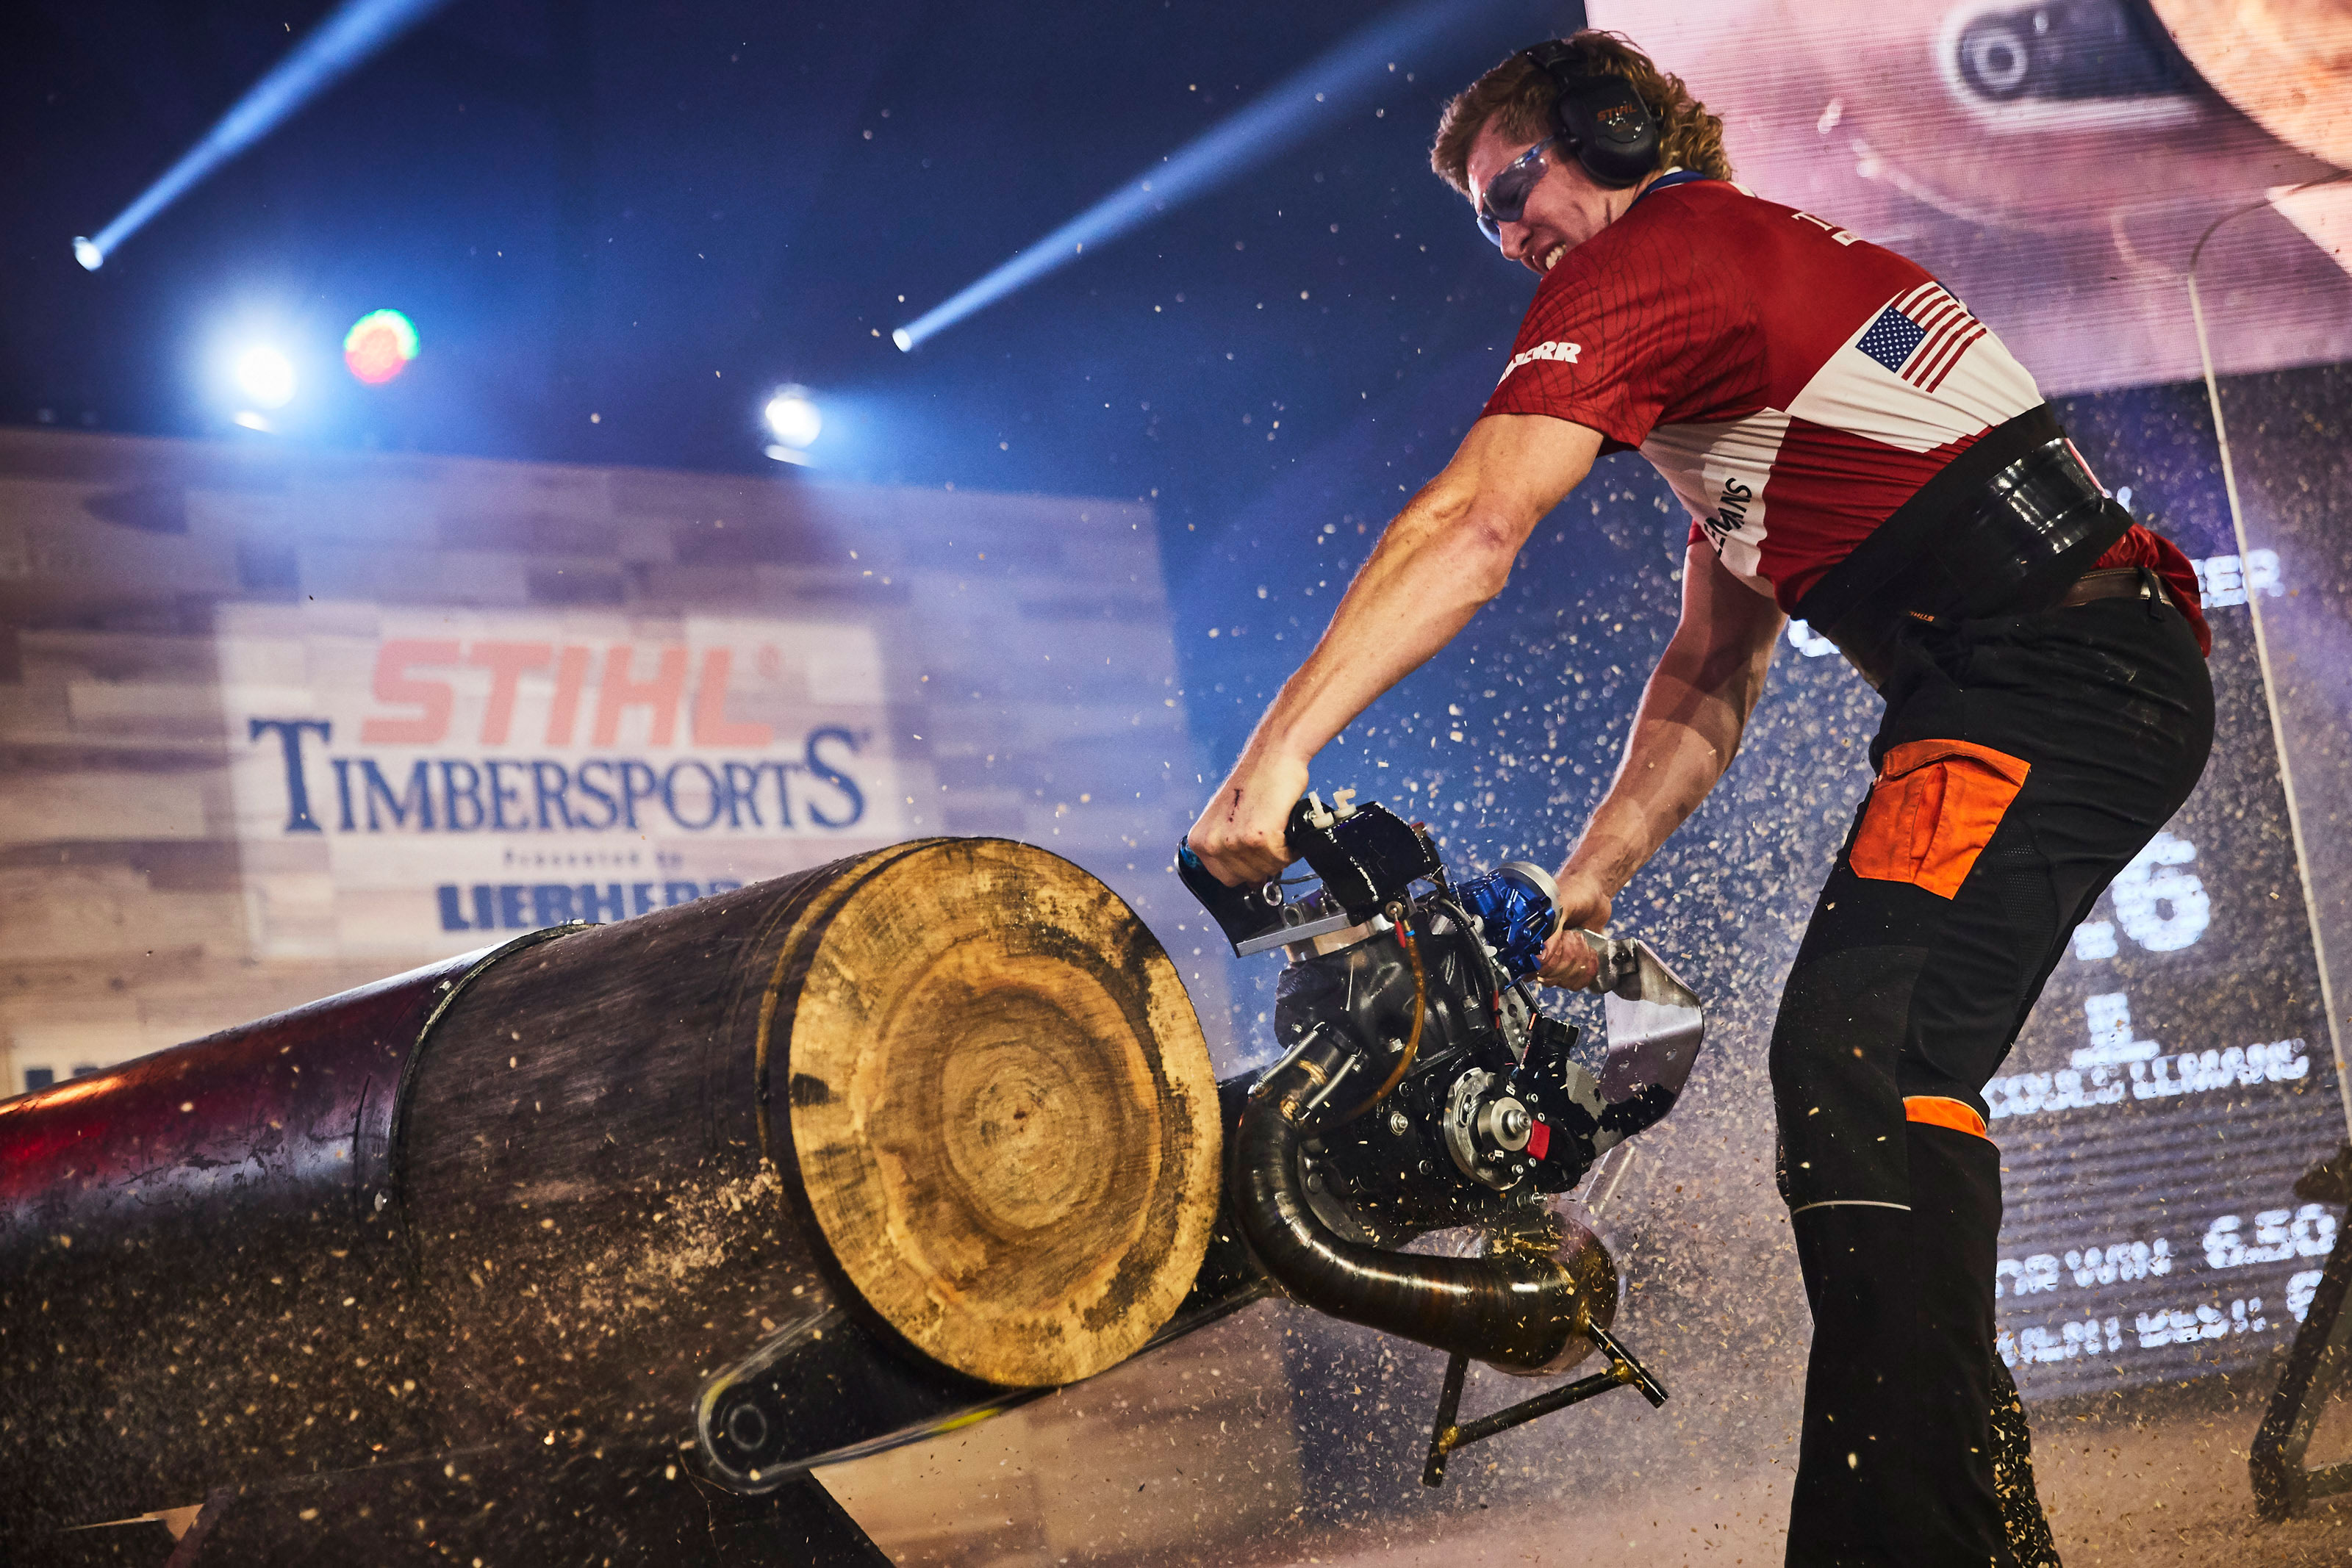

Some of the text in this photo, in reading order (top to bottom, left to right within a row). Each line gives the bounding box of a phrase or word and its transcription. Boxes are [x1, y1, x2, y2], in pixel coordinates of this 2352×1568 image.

[1597, 104, 1637, 122] STIHL
[359, 638, 773, 749] STIHL
[247, 717, 868, 835] TIMBERSPORTS
[435, 880, 744, 932] LIEBHE
